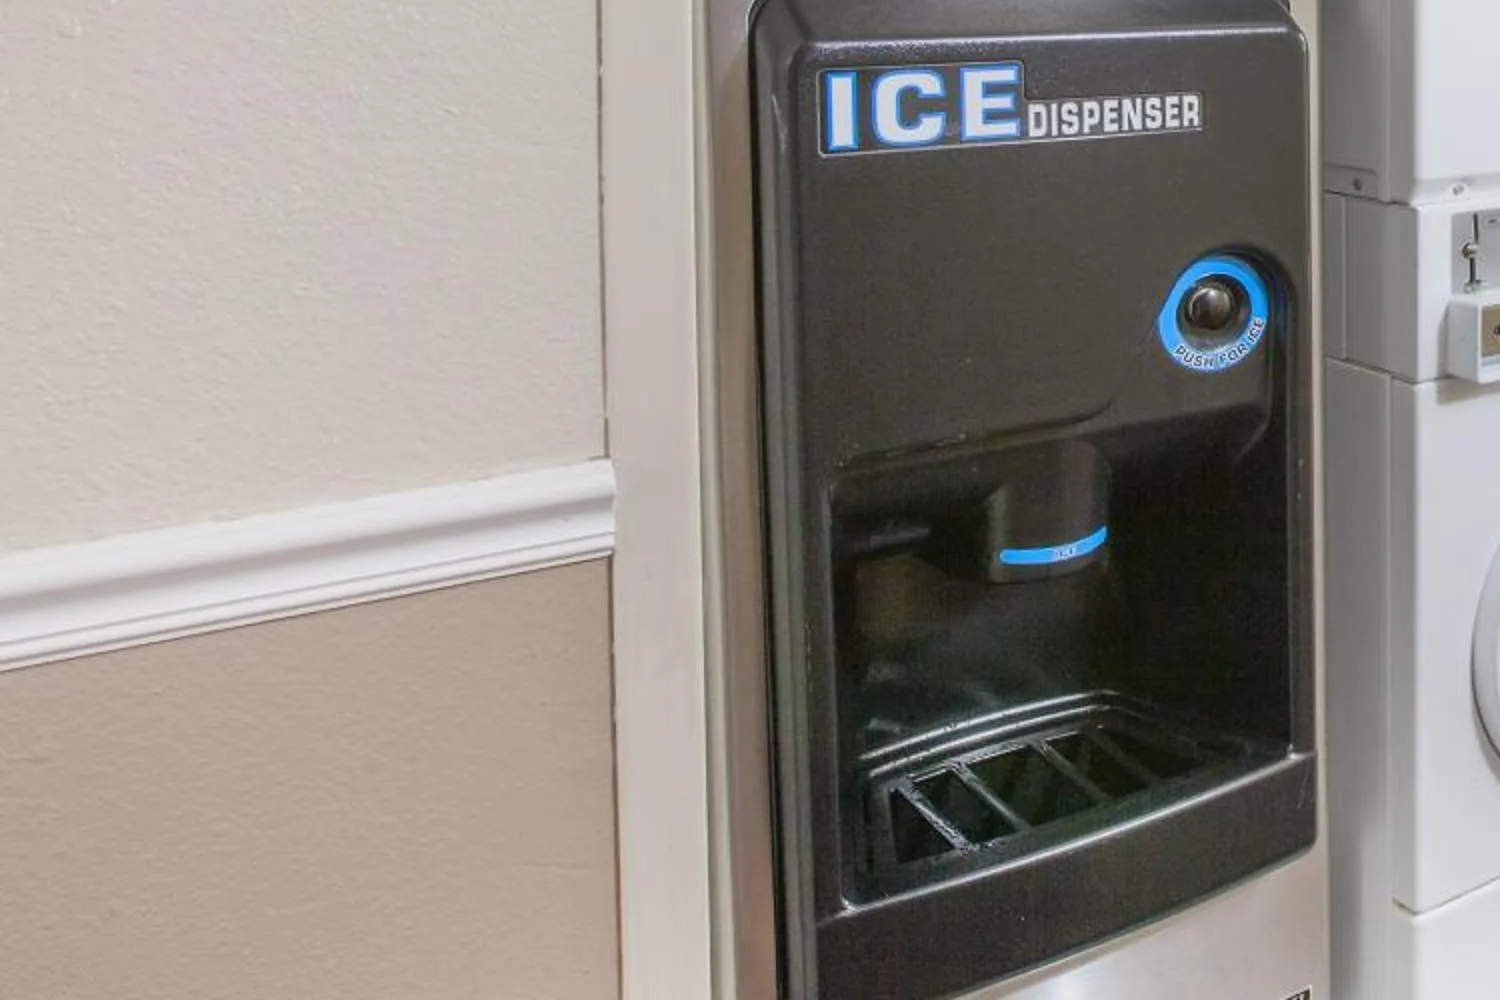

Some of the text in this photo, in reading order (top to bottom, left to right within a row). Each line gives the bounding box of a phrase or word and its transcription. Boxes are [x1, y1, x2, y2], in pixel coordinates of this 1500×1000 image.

[826, 65, 1200, 153] ICE DISPENSER
[1175, 318, 1264, 368] PUSH FOR ICE
